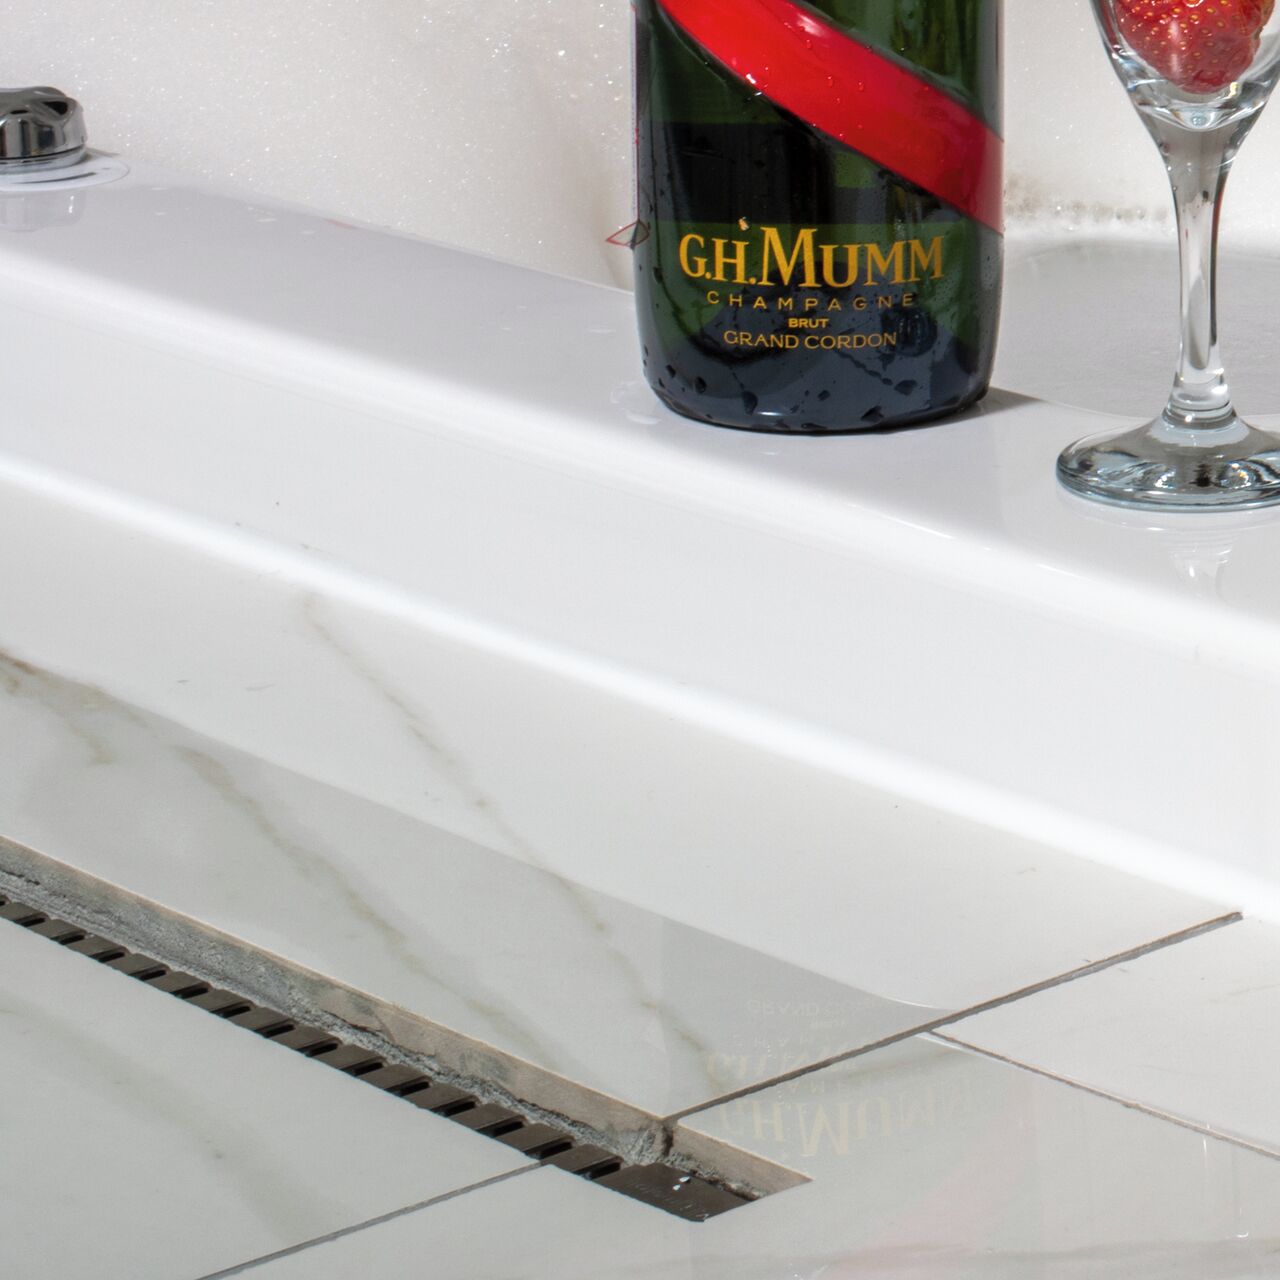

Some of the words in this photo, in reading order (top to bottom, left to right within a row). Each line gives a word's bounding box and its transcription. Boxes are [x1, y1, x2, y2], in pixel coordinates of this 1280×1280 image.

[706, 290, 915, 312] CHAMPAGNE
[788, 317, 830, 330] BRUT
[723, 330, 799, 350] GRAND
[803, 331, 898, 350] CORDON
